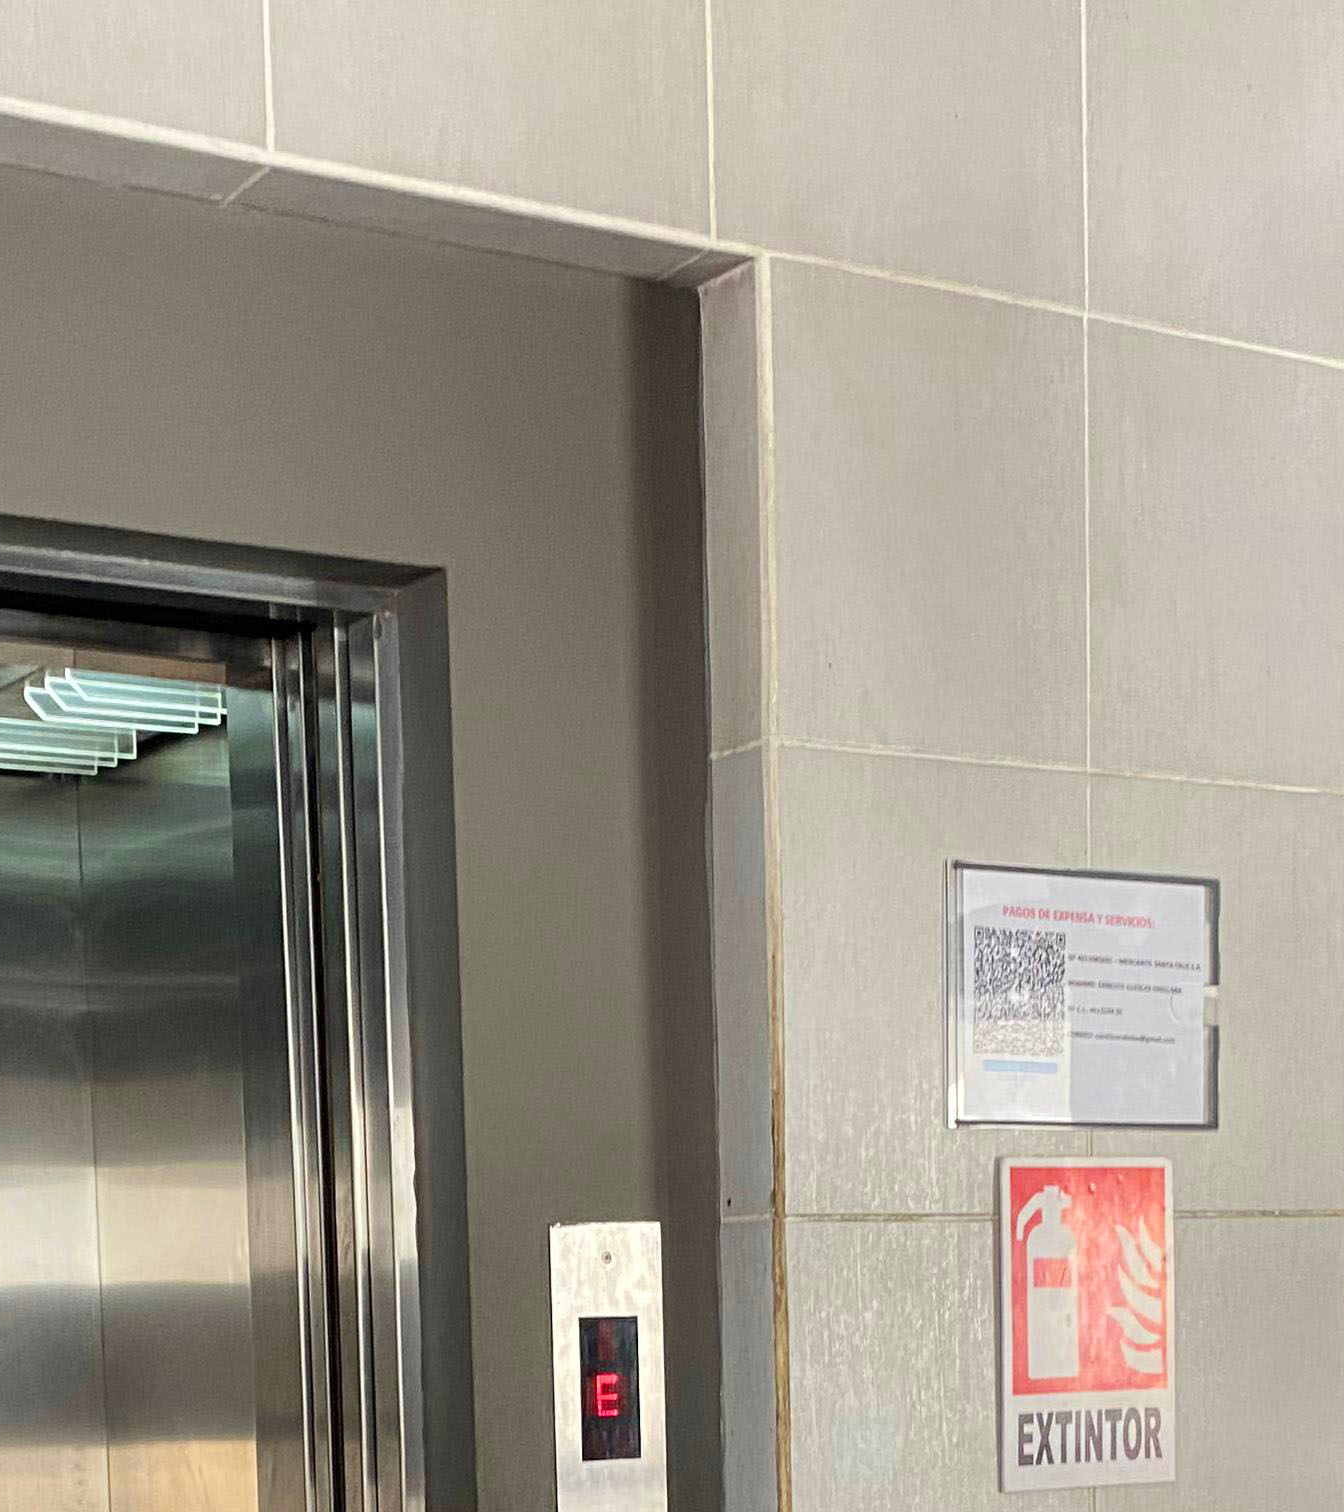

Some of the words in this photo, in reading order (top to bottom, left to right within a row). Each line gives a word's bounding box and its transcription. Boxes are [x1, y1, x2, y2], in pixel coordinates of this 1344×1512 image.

[1002, 904, 1036, 920] PAGOS
[1038, 908, 1050, 921] DE
[1053, 909, 1095, 924] EXPENSA
[1095, 914, 1103, 923] Y
[595, 1373, 619, 1416] E
[1017, 1407, 1163, 1467] EXTINTOR
